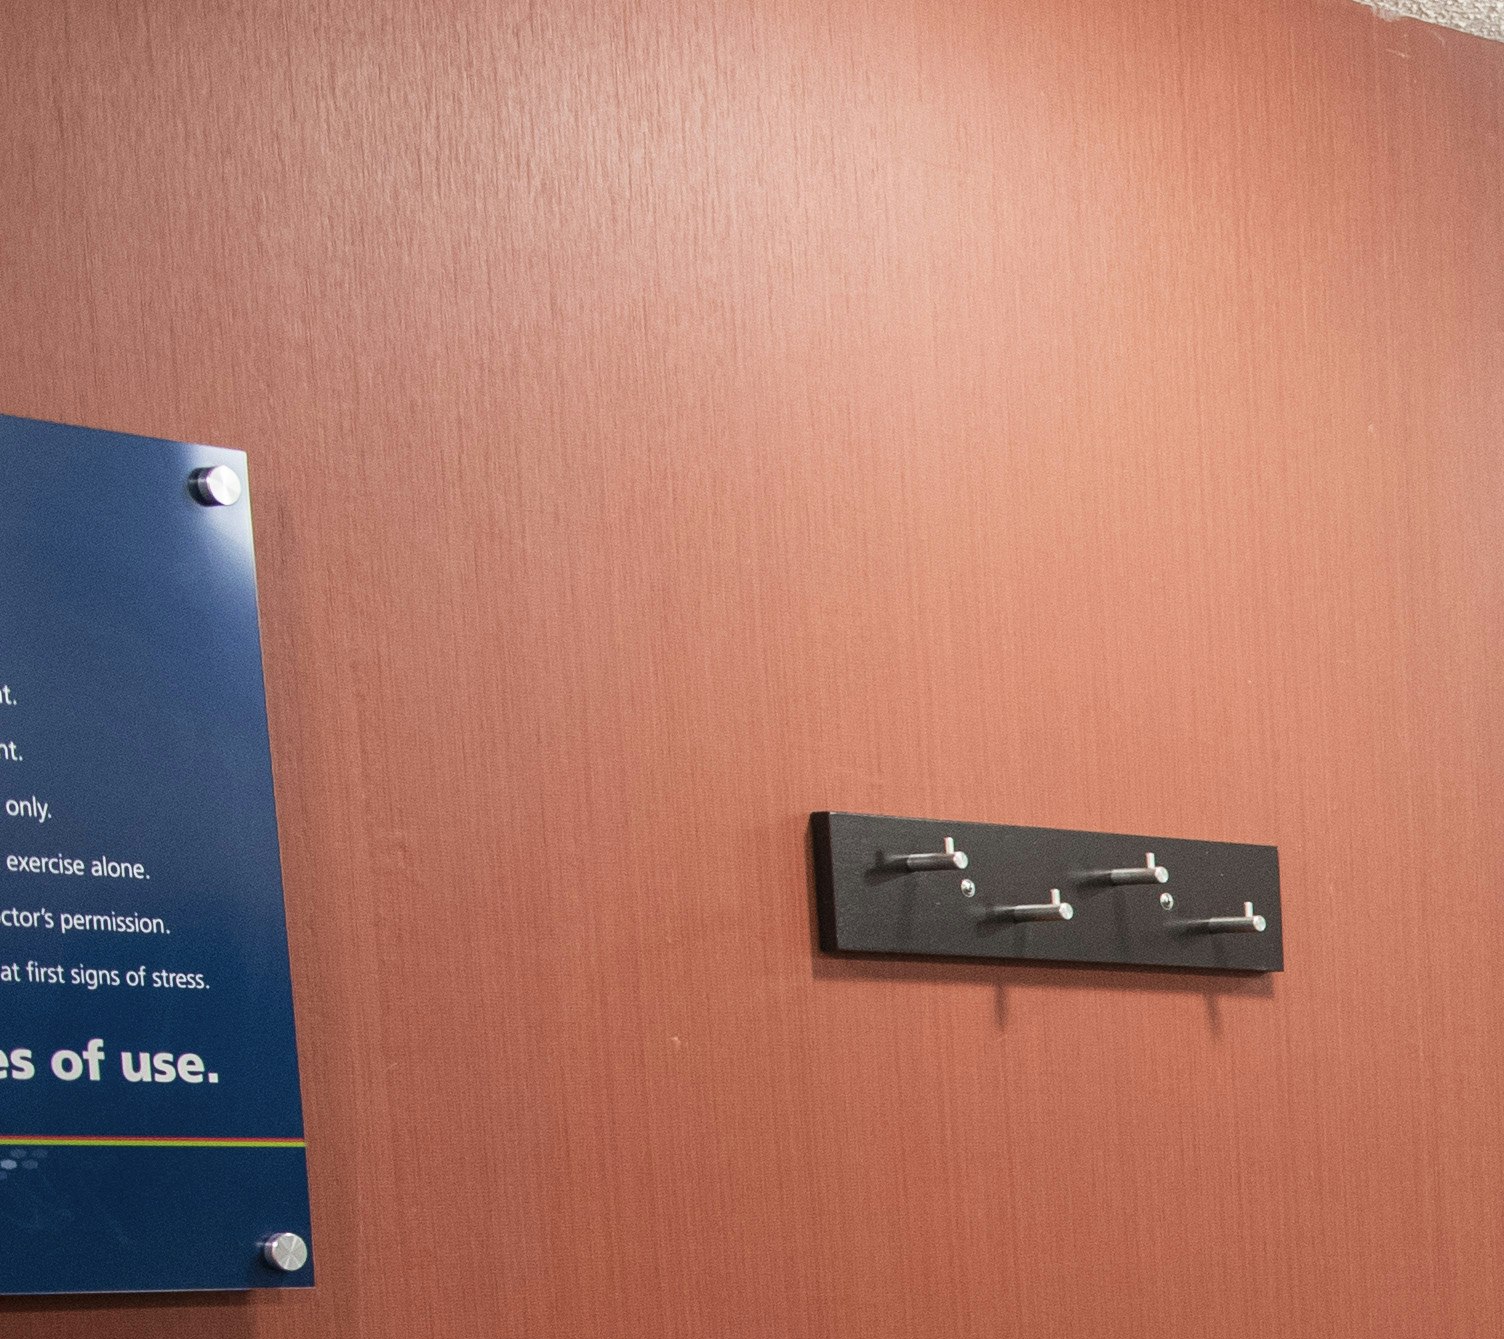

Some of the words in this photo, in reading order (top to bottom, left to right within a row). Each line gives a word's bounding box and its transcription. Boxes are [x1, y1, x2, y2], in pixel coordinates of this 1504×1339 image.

[6, 795, 51, 823] only.
[6, 853, 85, 875] exercise
[91, 856, 151, 879] alone.
[0, 907, 55, 928] ctor's
[60, 911, 170, 934] permission.
[0, 962, 21, 982] at
[26, 961, 65, 984] first
[71, 964, 120, 990] signs
[126, 966, 146, 986] of
[152, 969, 210, 989] stress.
[51, 1038, 105, 1082] of
[121, 1051, 219, 1084] use.
